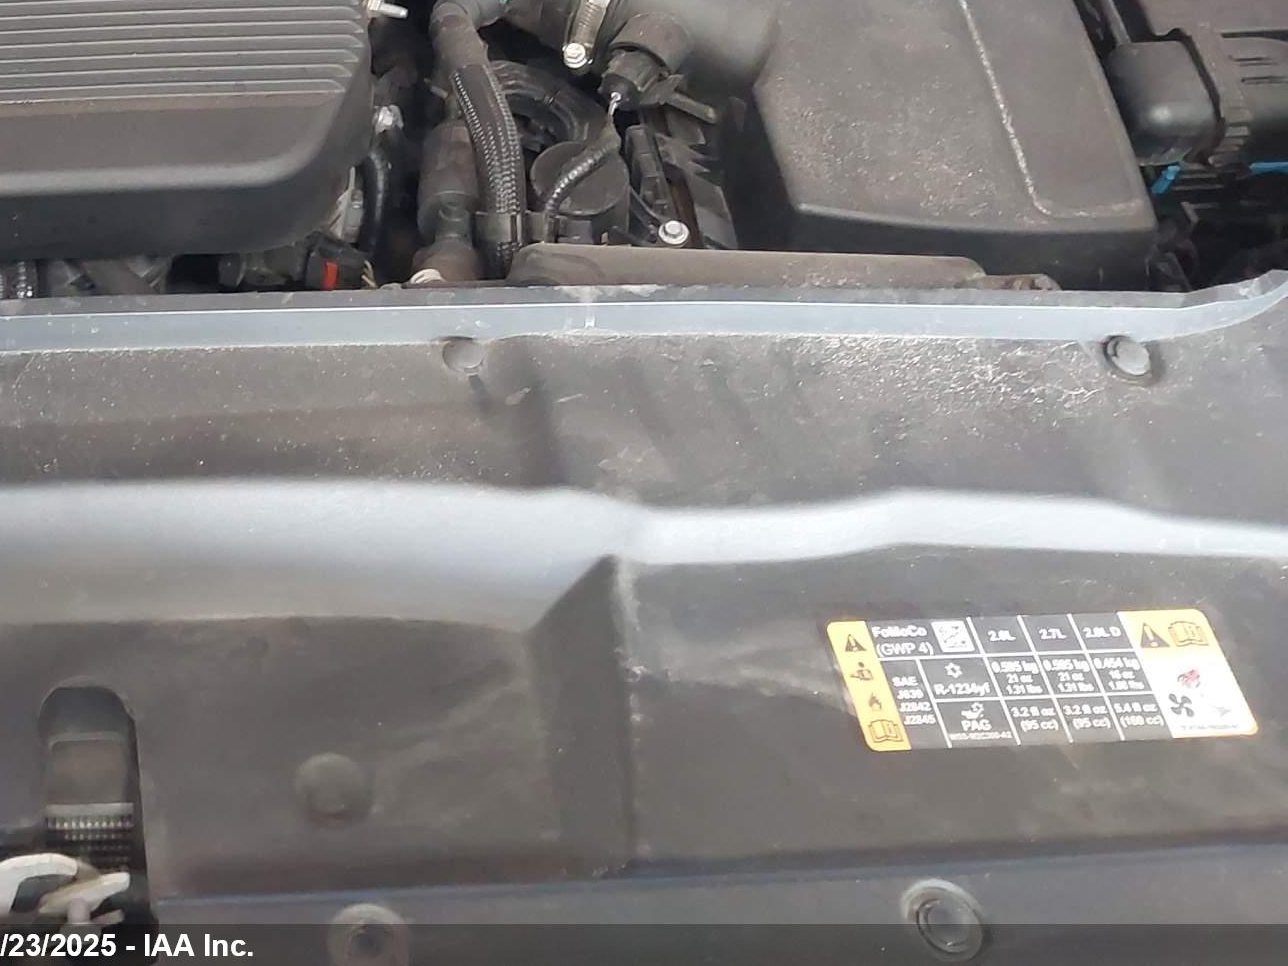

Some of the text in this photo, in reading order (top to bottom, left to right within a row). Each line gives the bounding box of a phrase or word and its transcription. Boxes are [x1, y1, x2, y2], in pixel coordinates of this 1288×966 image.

[870, 624, 927, 638] FoMoCo
[875, 641, 934, 657] (GWP 4)
[1021, 660, 1038, 673] kg
[1073, 658, 1089, 672] kg
[1123, 656, 1140, 670] kg
[961, 720, 992, 731] PAG
[1039, 719, 1059, 730] cc)
[1091, 717, 1111, 728] cc)
[1145, 715, 1165, 726] cc)
